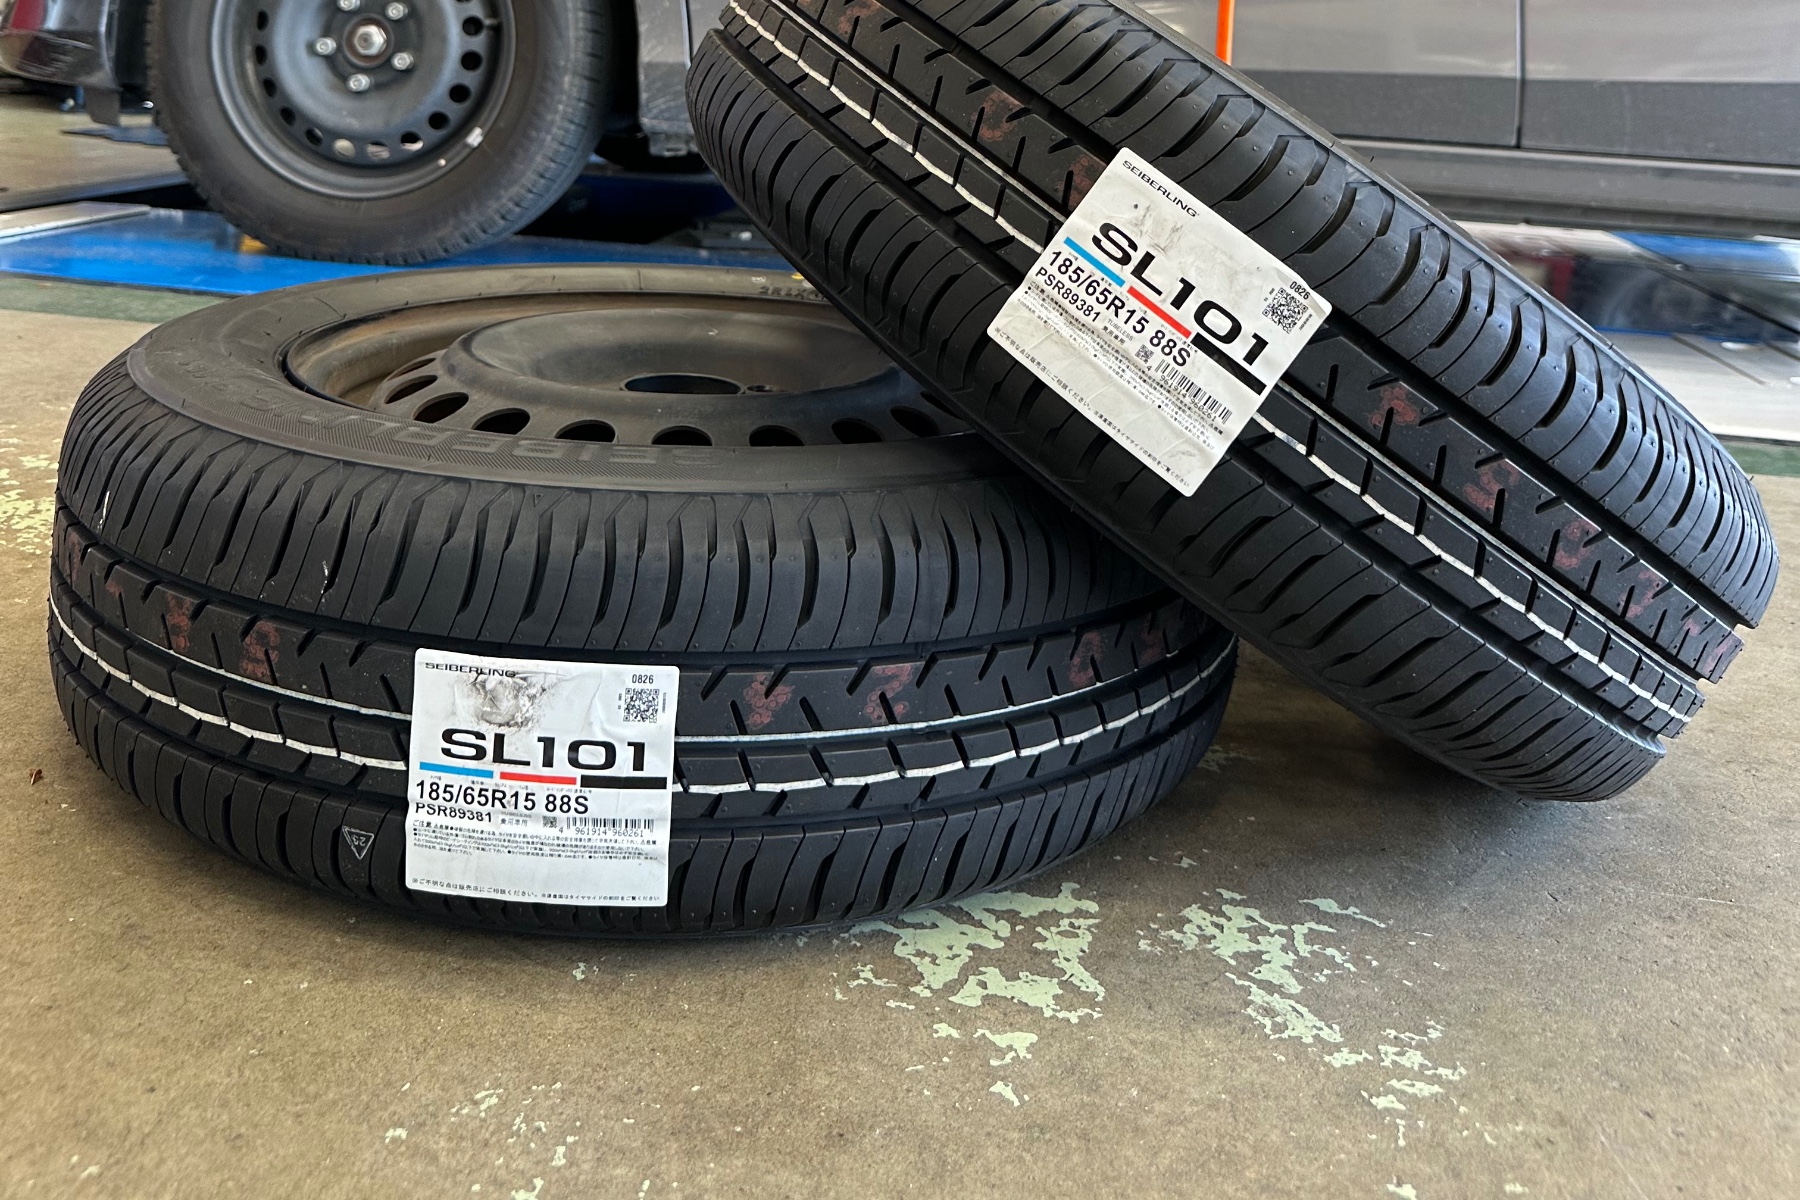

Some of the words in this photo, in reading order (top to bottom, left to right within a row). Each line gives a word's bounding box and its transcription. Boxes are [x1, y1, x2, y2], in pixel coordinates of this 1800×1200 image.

[1122, 160, 1199, 217] SEIBERLING
[1035, 266, 1101, 323] PSR89381
[1091, 222, 1269, 367] SL101
[1290, 281, 1310, 300] 0826
[1049, 251, 1149, 334] 185/65R15
[1149, 330, 1191, 367] 88S
[1107, 318, 1134, 343] TUBELESS
[1159, 374, 1187, 400] 961914
[1190, 397, 1218, 423] 960261
[425, 662, 517, 678] SEIBERLING
[632, 674, 654, 684] 0826
[441, 727, 646, 772] SL101
[415, 802, 493, 823] PSR89381
[416, 780, 536, 811] 185/65R15
[544, 794, 589, 815] 88S
[575, 827, 608, 836] 961914
[612, 828, 644, 837] 960261
